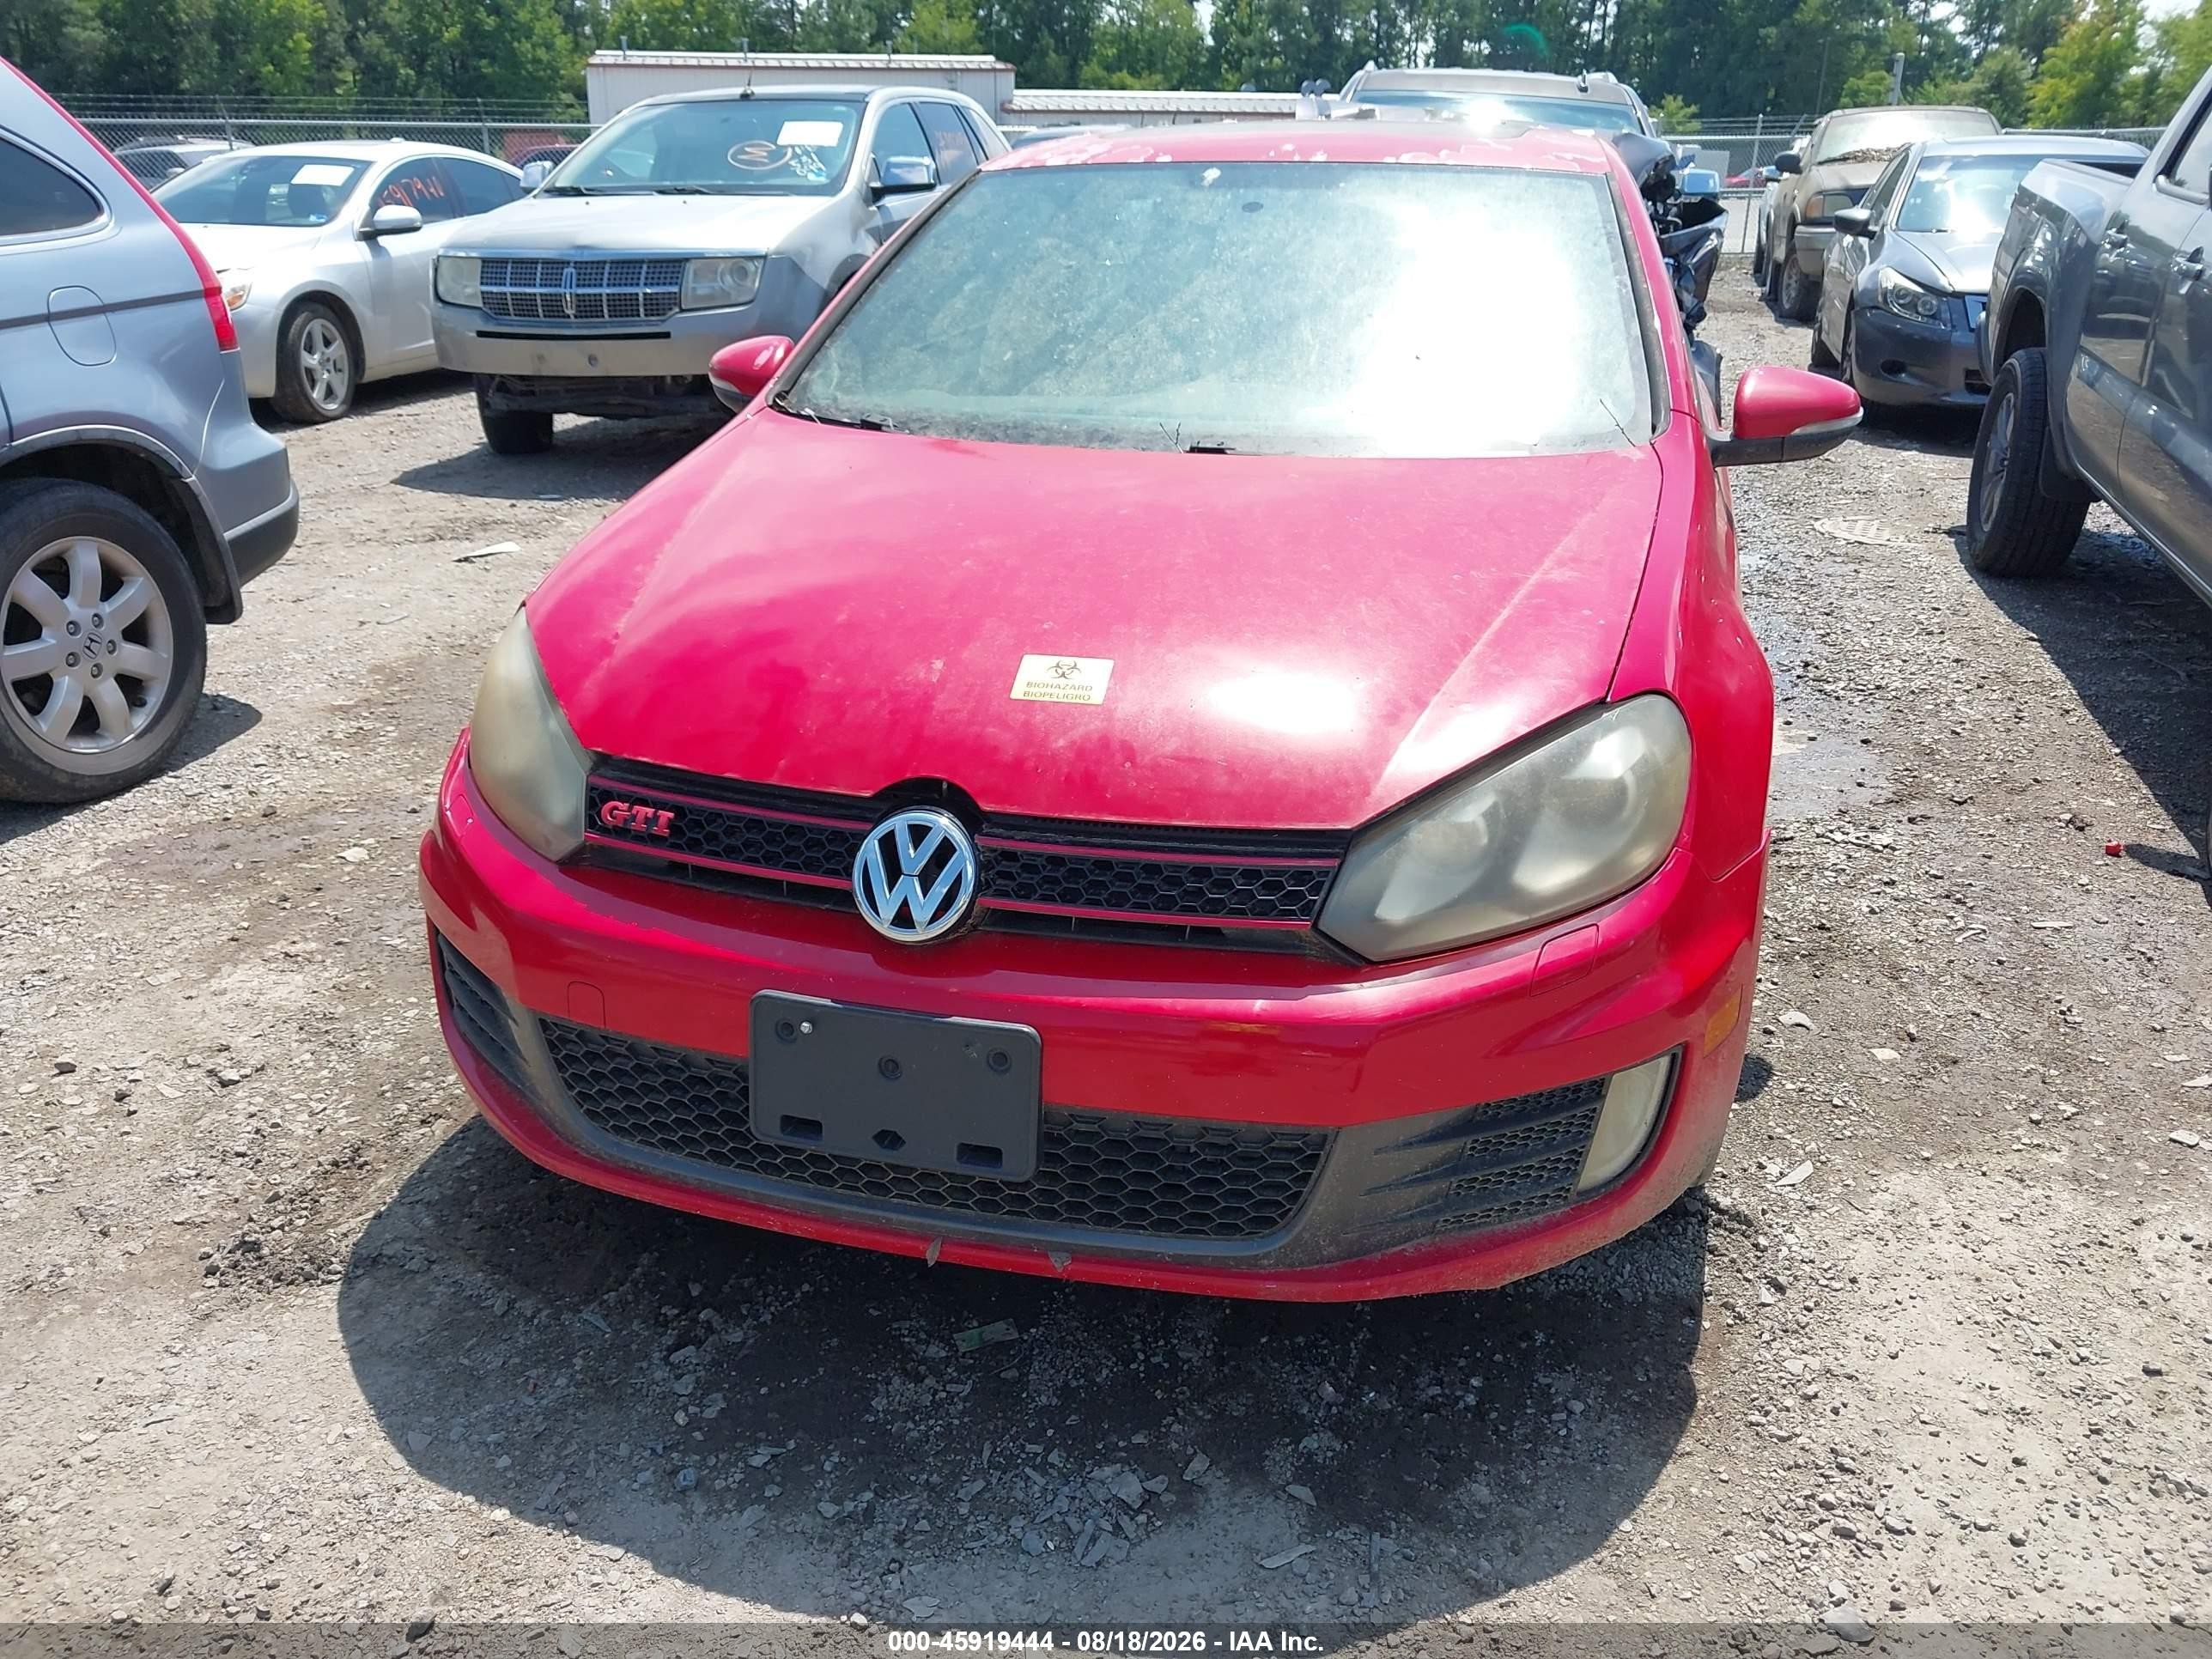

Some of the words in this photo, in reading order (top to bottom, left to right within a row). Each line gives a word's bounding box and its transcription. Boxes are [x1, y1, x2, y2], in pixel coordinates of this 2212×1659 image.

[1023, 691, 1091, 701] BIOPELIGRO
[1026, 682, 1092, 691] BIOHAZARD
[601, 800, 675, 837] GTI
[857, 813, 972, 938] VW
